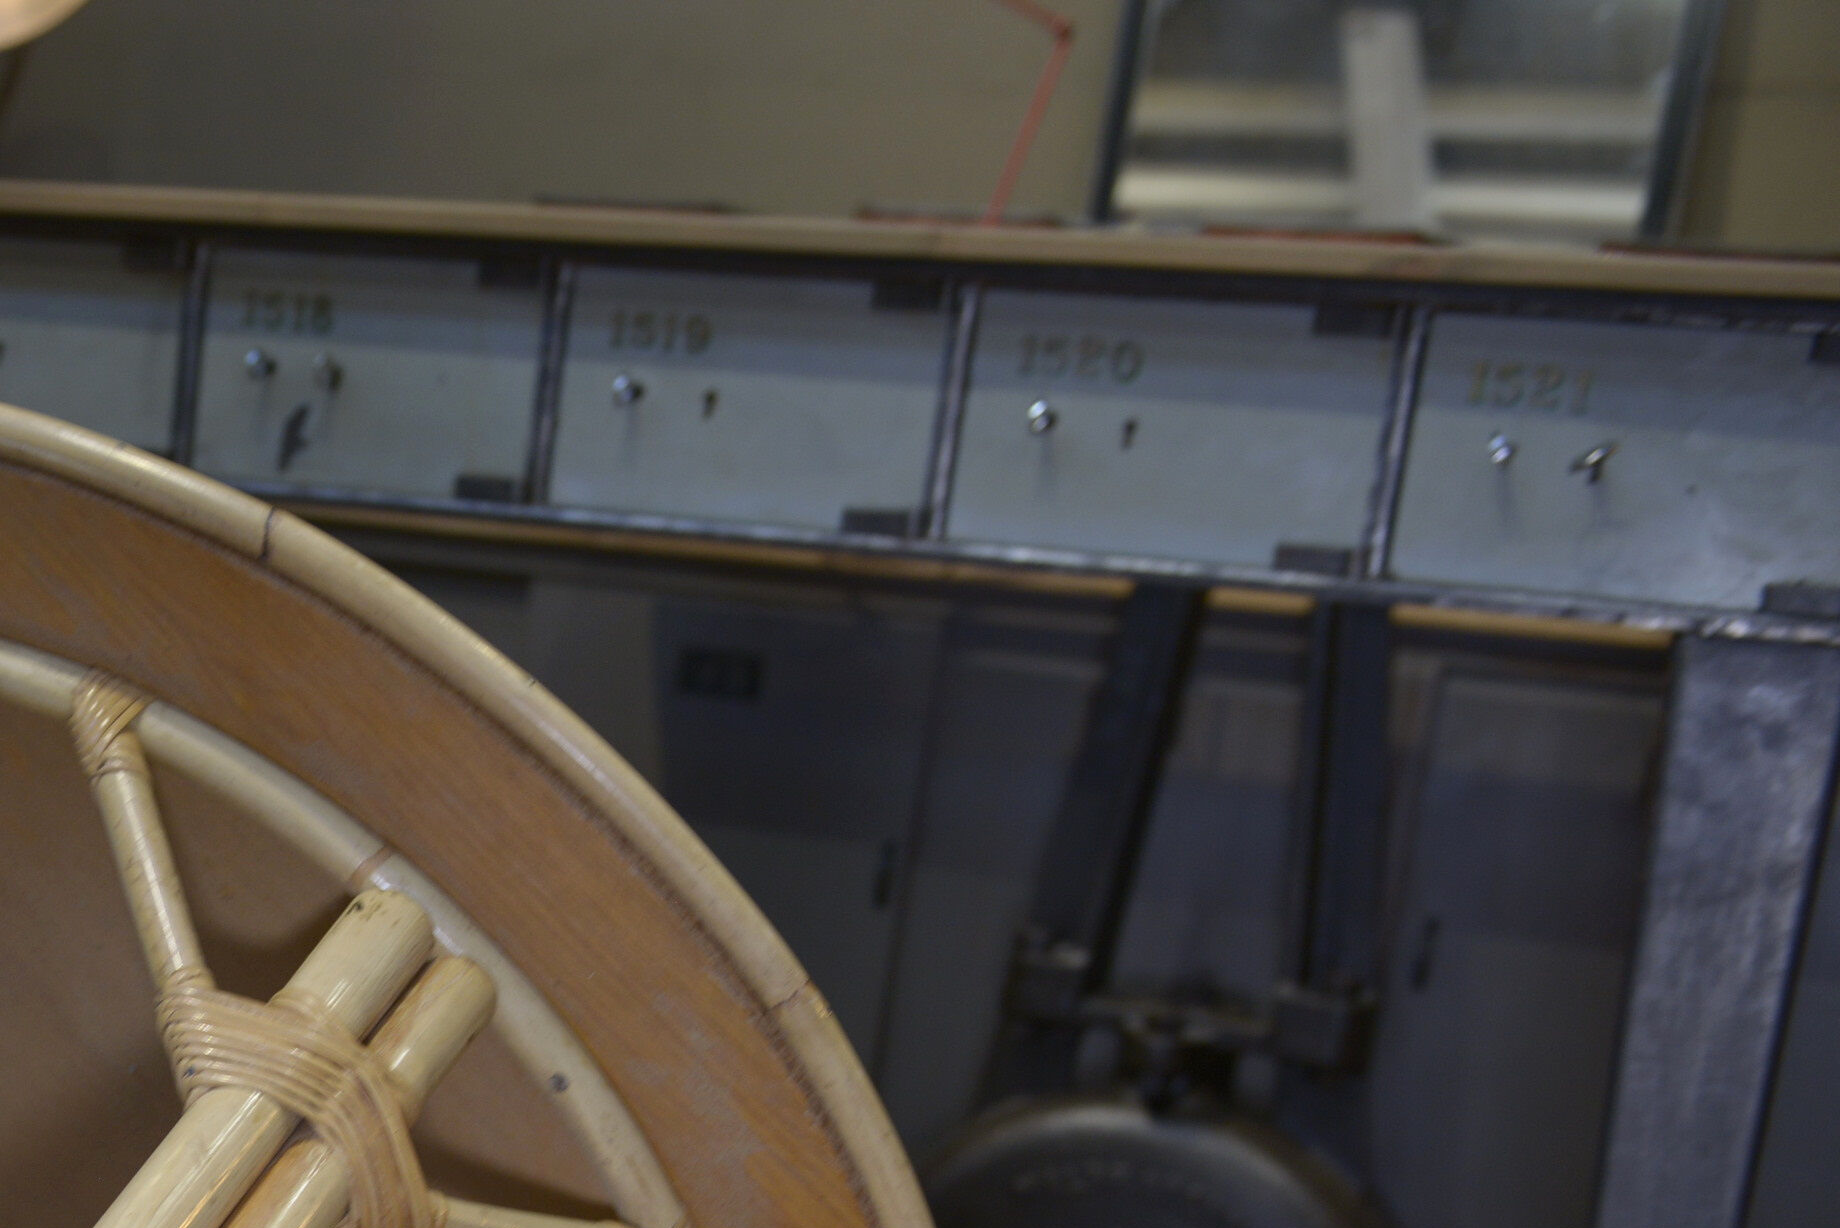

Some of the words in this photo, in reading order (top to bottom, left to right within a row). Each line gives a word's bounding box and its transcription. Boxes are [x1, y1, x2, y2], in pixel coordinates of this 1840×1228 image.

[241, 289, 335, 334] 1518
[609, 310, 713, 355] 1519
[1017, 333, 1145, 384] 1520
[1469, 358, 1595, 415] 1521
